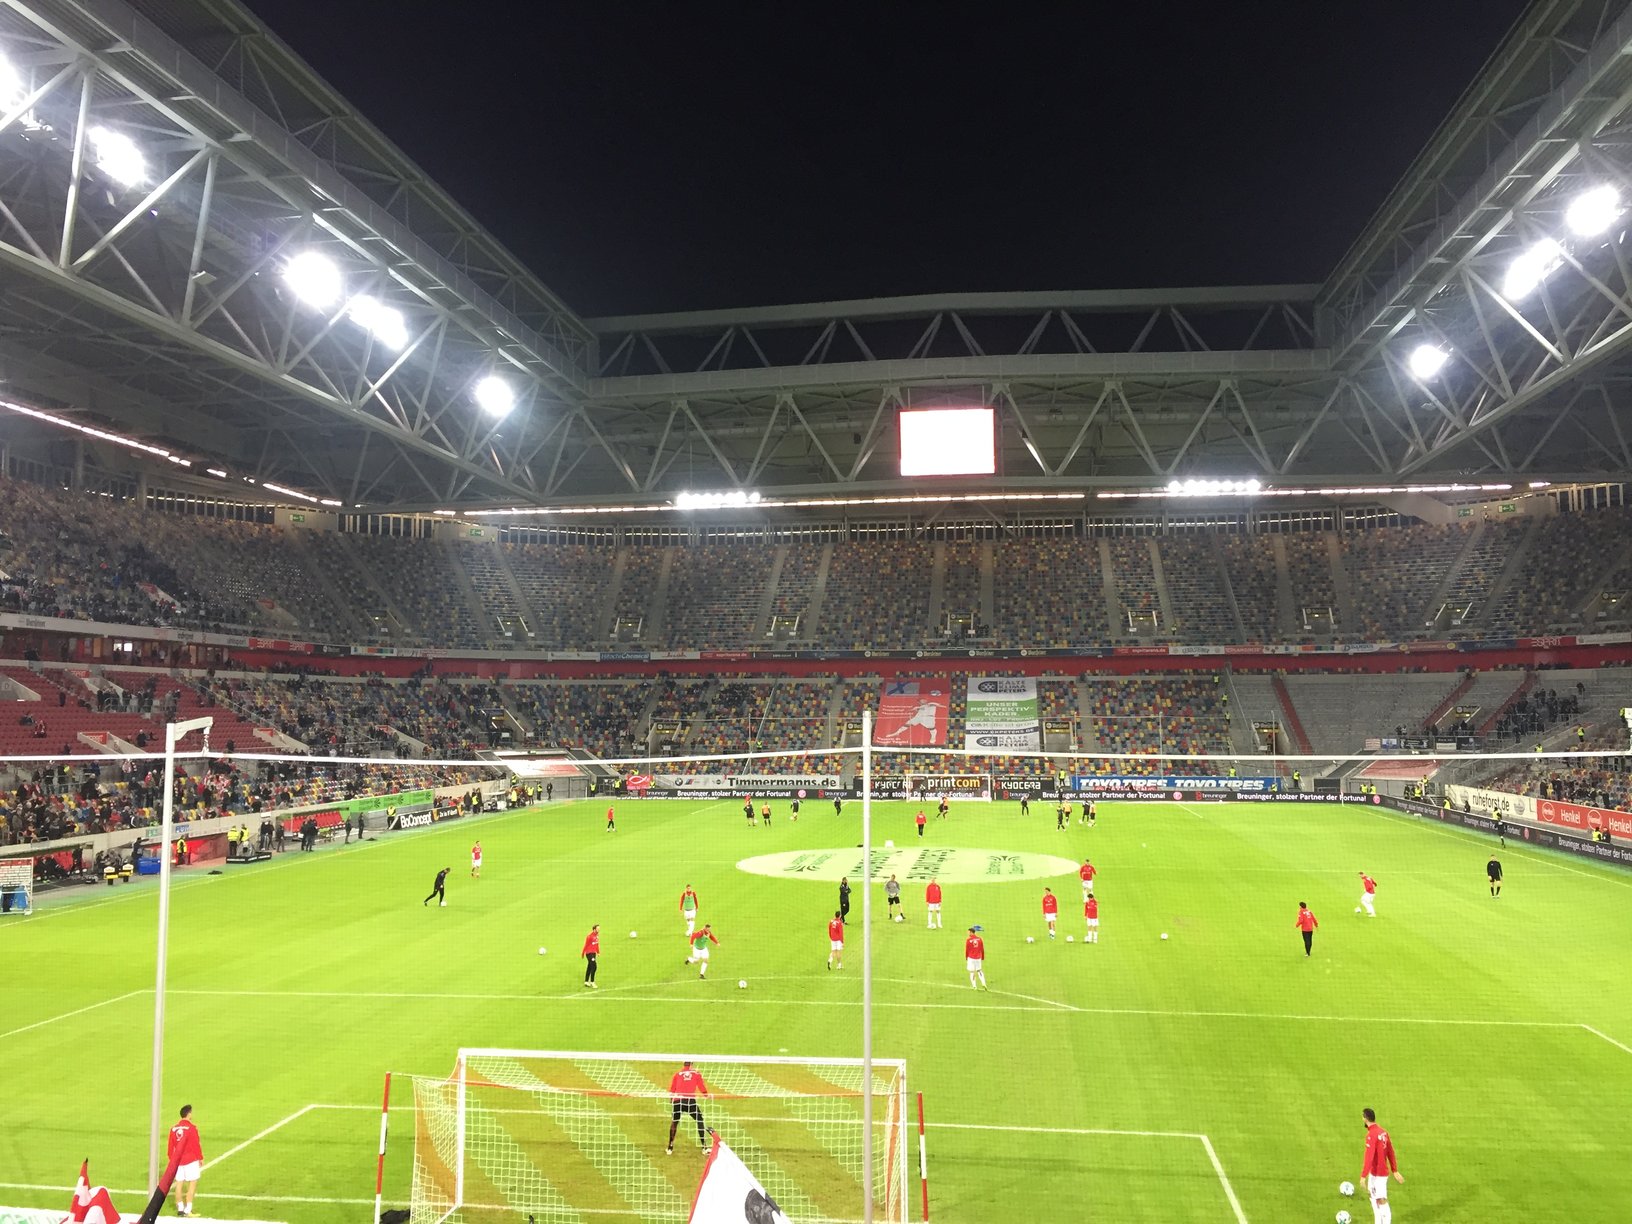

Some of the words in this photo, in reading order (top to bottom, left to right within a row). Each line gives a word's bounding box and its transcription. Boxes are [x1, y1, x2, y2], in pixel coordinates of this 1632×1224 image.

[727, 777, 837, 787] Timmermanns.de
[927, 776, 980, 790] printcom
[1001, 781, 1041, 790] KYOCERA
[1080, 779, 1121, 787] TOYO
[1174, 779, 1216, 789] TOYO
[1218, 780, 1264, 790] TIRES
[677, 790, 711, 798] Breuninger,
[766, 790, 791, 798] Fortuna!
[1079, 791, 1100, 799] stolzer
[1102, 791, 1125, 799] Partner
[1127, 791, 1138, 799] der
[1236, 793, 1275, 801] Breuninger,
[1300, 793, 1325, 801] Partner
[1326, 793, 1337, 801] der
[1472, 793, 1510, 811] ruheforst.de
[400, 812, 433, 828] BoConcept
[1560, 808, 1581, 824] Henkel
[1608, 817, 1632, 834] Henkel
